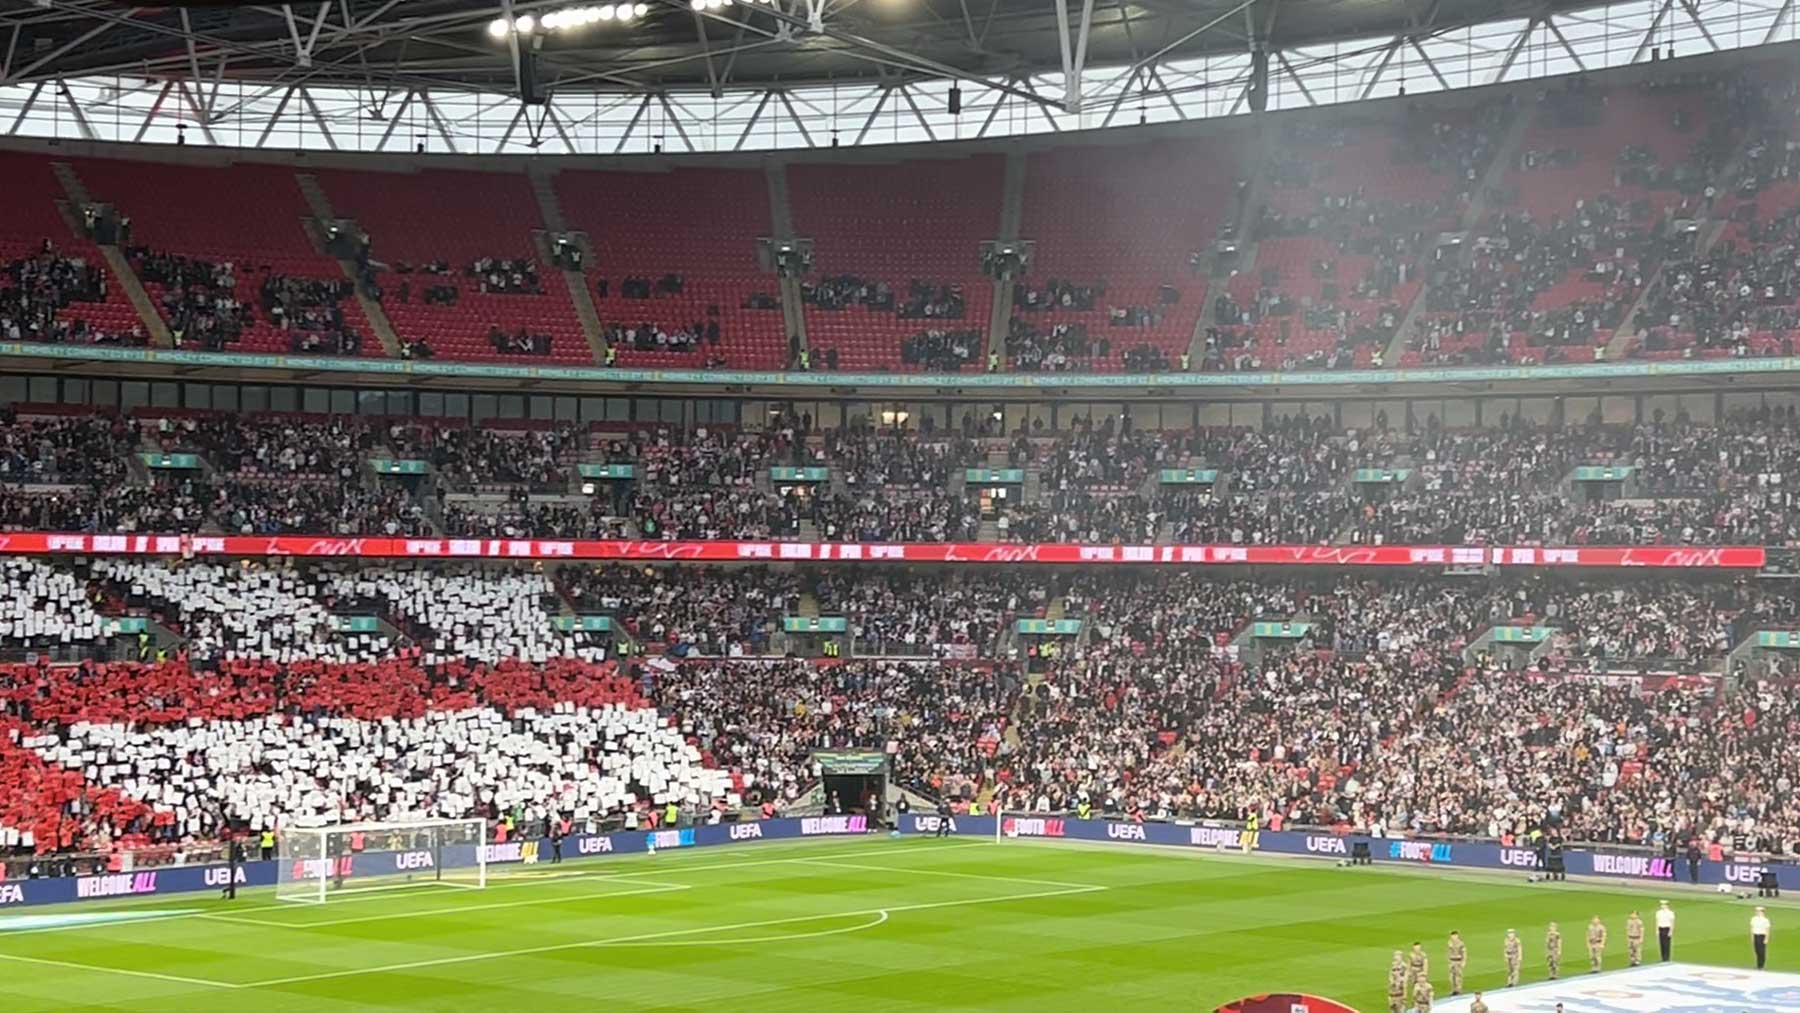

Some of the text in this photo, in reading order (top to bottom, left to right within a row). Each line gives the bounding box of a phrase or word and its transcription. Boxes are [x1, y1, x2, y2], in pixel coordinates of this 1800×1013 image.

[730, 823, 762, 840] UEFA
[1108, 823, 1146, 840] UEFA
[579, 836, 613, 854] UEFA
[1306, 836, 1346, 853] UEFA
[396, 851, 434, 869] UEFA
